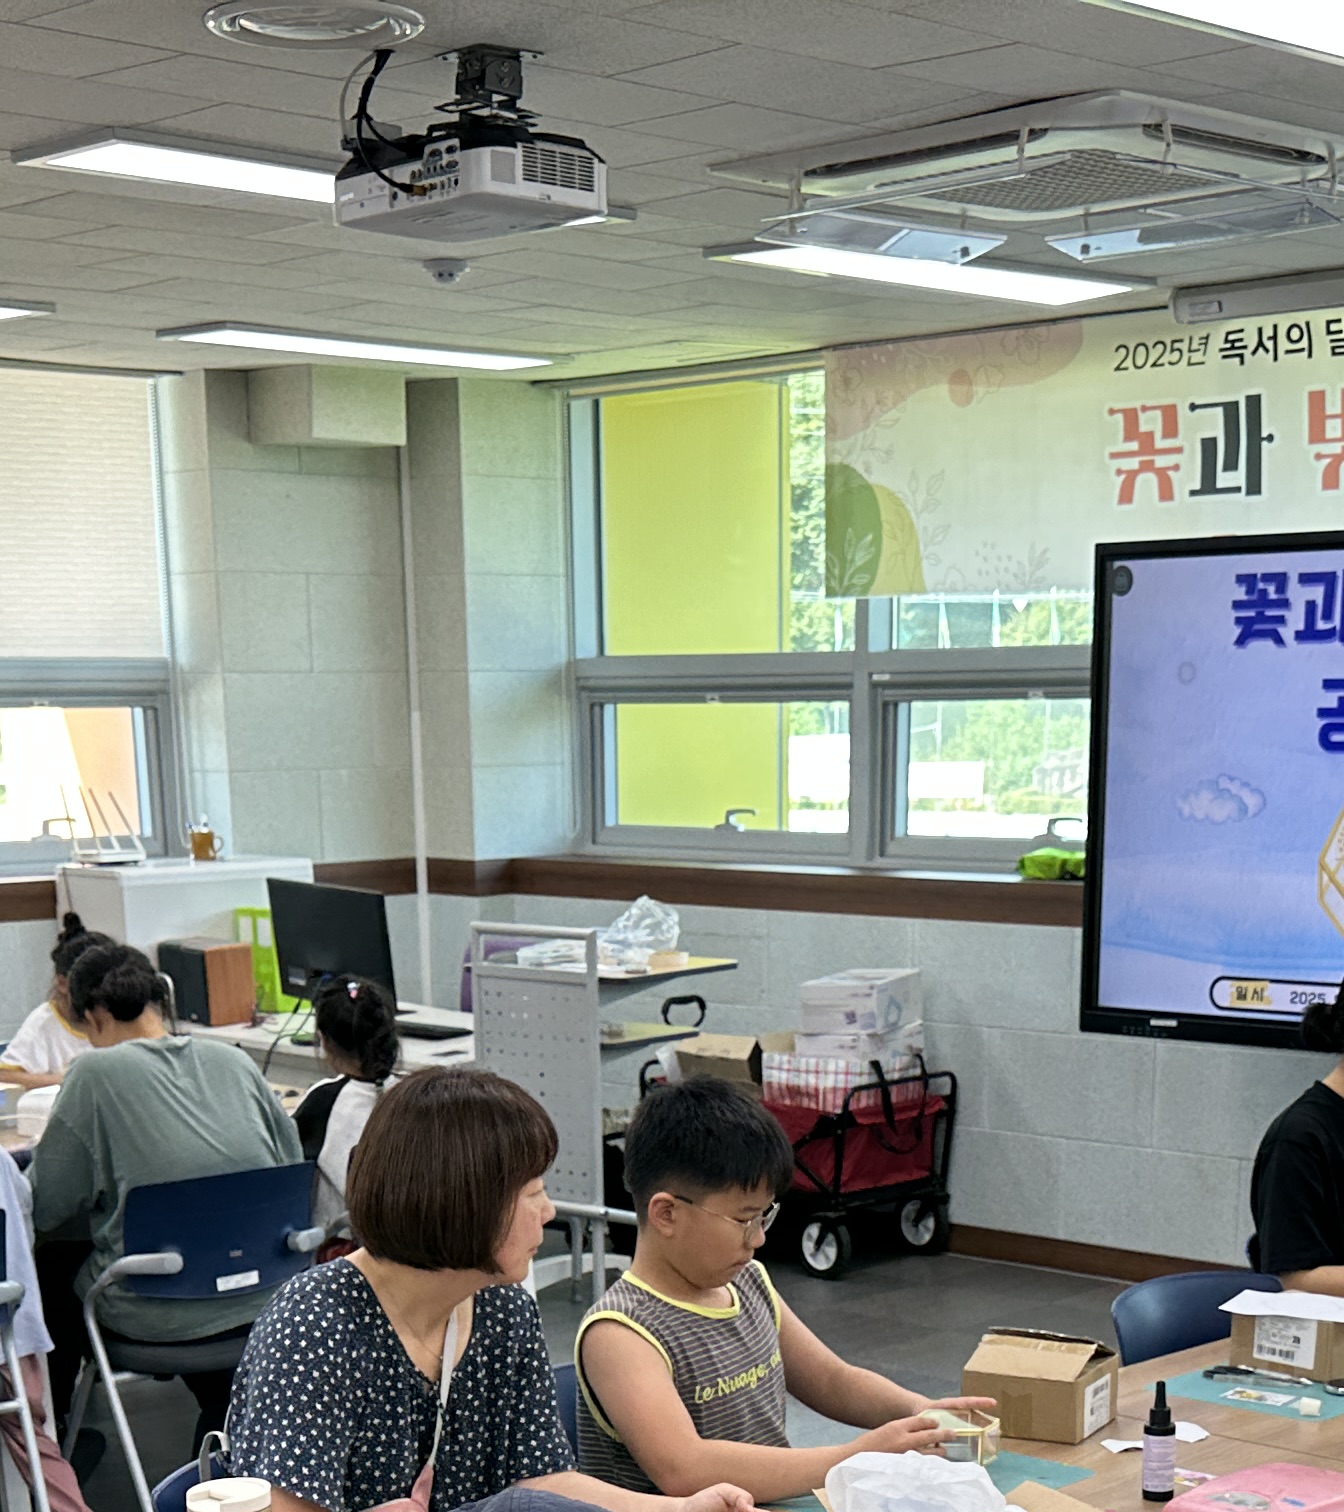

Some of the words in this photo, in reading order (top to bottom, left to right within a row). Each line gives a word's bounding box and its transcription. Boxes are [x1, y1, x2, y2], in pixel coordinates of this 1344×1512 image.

[1113, 332, 1210, 373] 2025년
[1218, 319, 1315, 367] 독서의
[1107, 393, 1275, 507] 꽃과
[694, 1385, 716, 1404] Le
